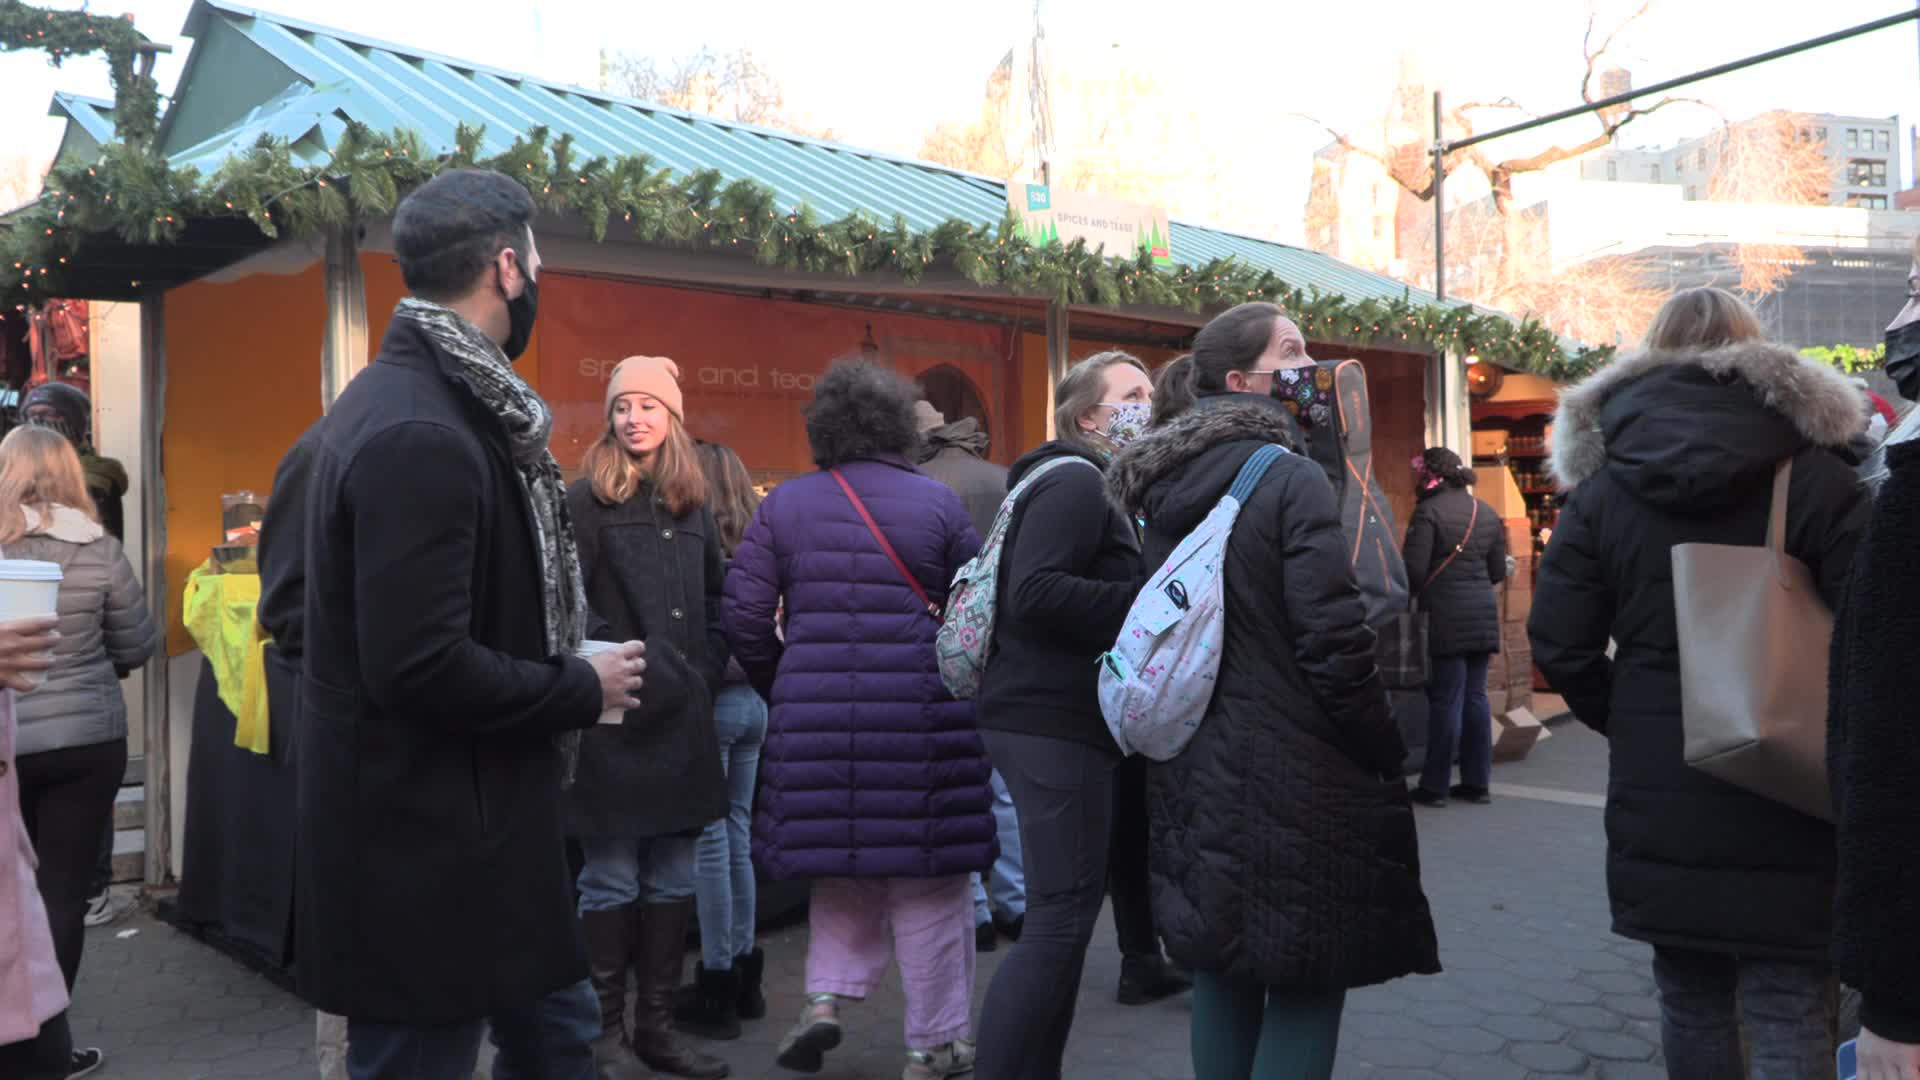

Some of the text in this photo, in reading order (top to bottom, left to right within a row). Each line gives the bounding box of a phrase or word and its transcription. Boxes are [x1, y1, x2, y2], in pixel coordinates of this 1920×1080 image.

[1057, 211, 1089, 226] SPICES
[1090, 217, 1108, 229] AND
[698, 364, 760, 386] and
